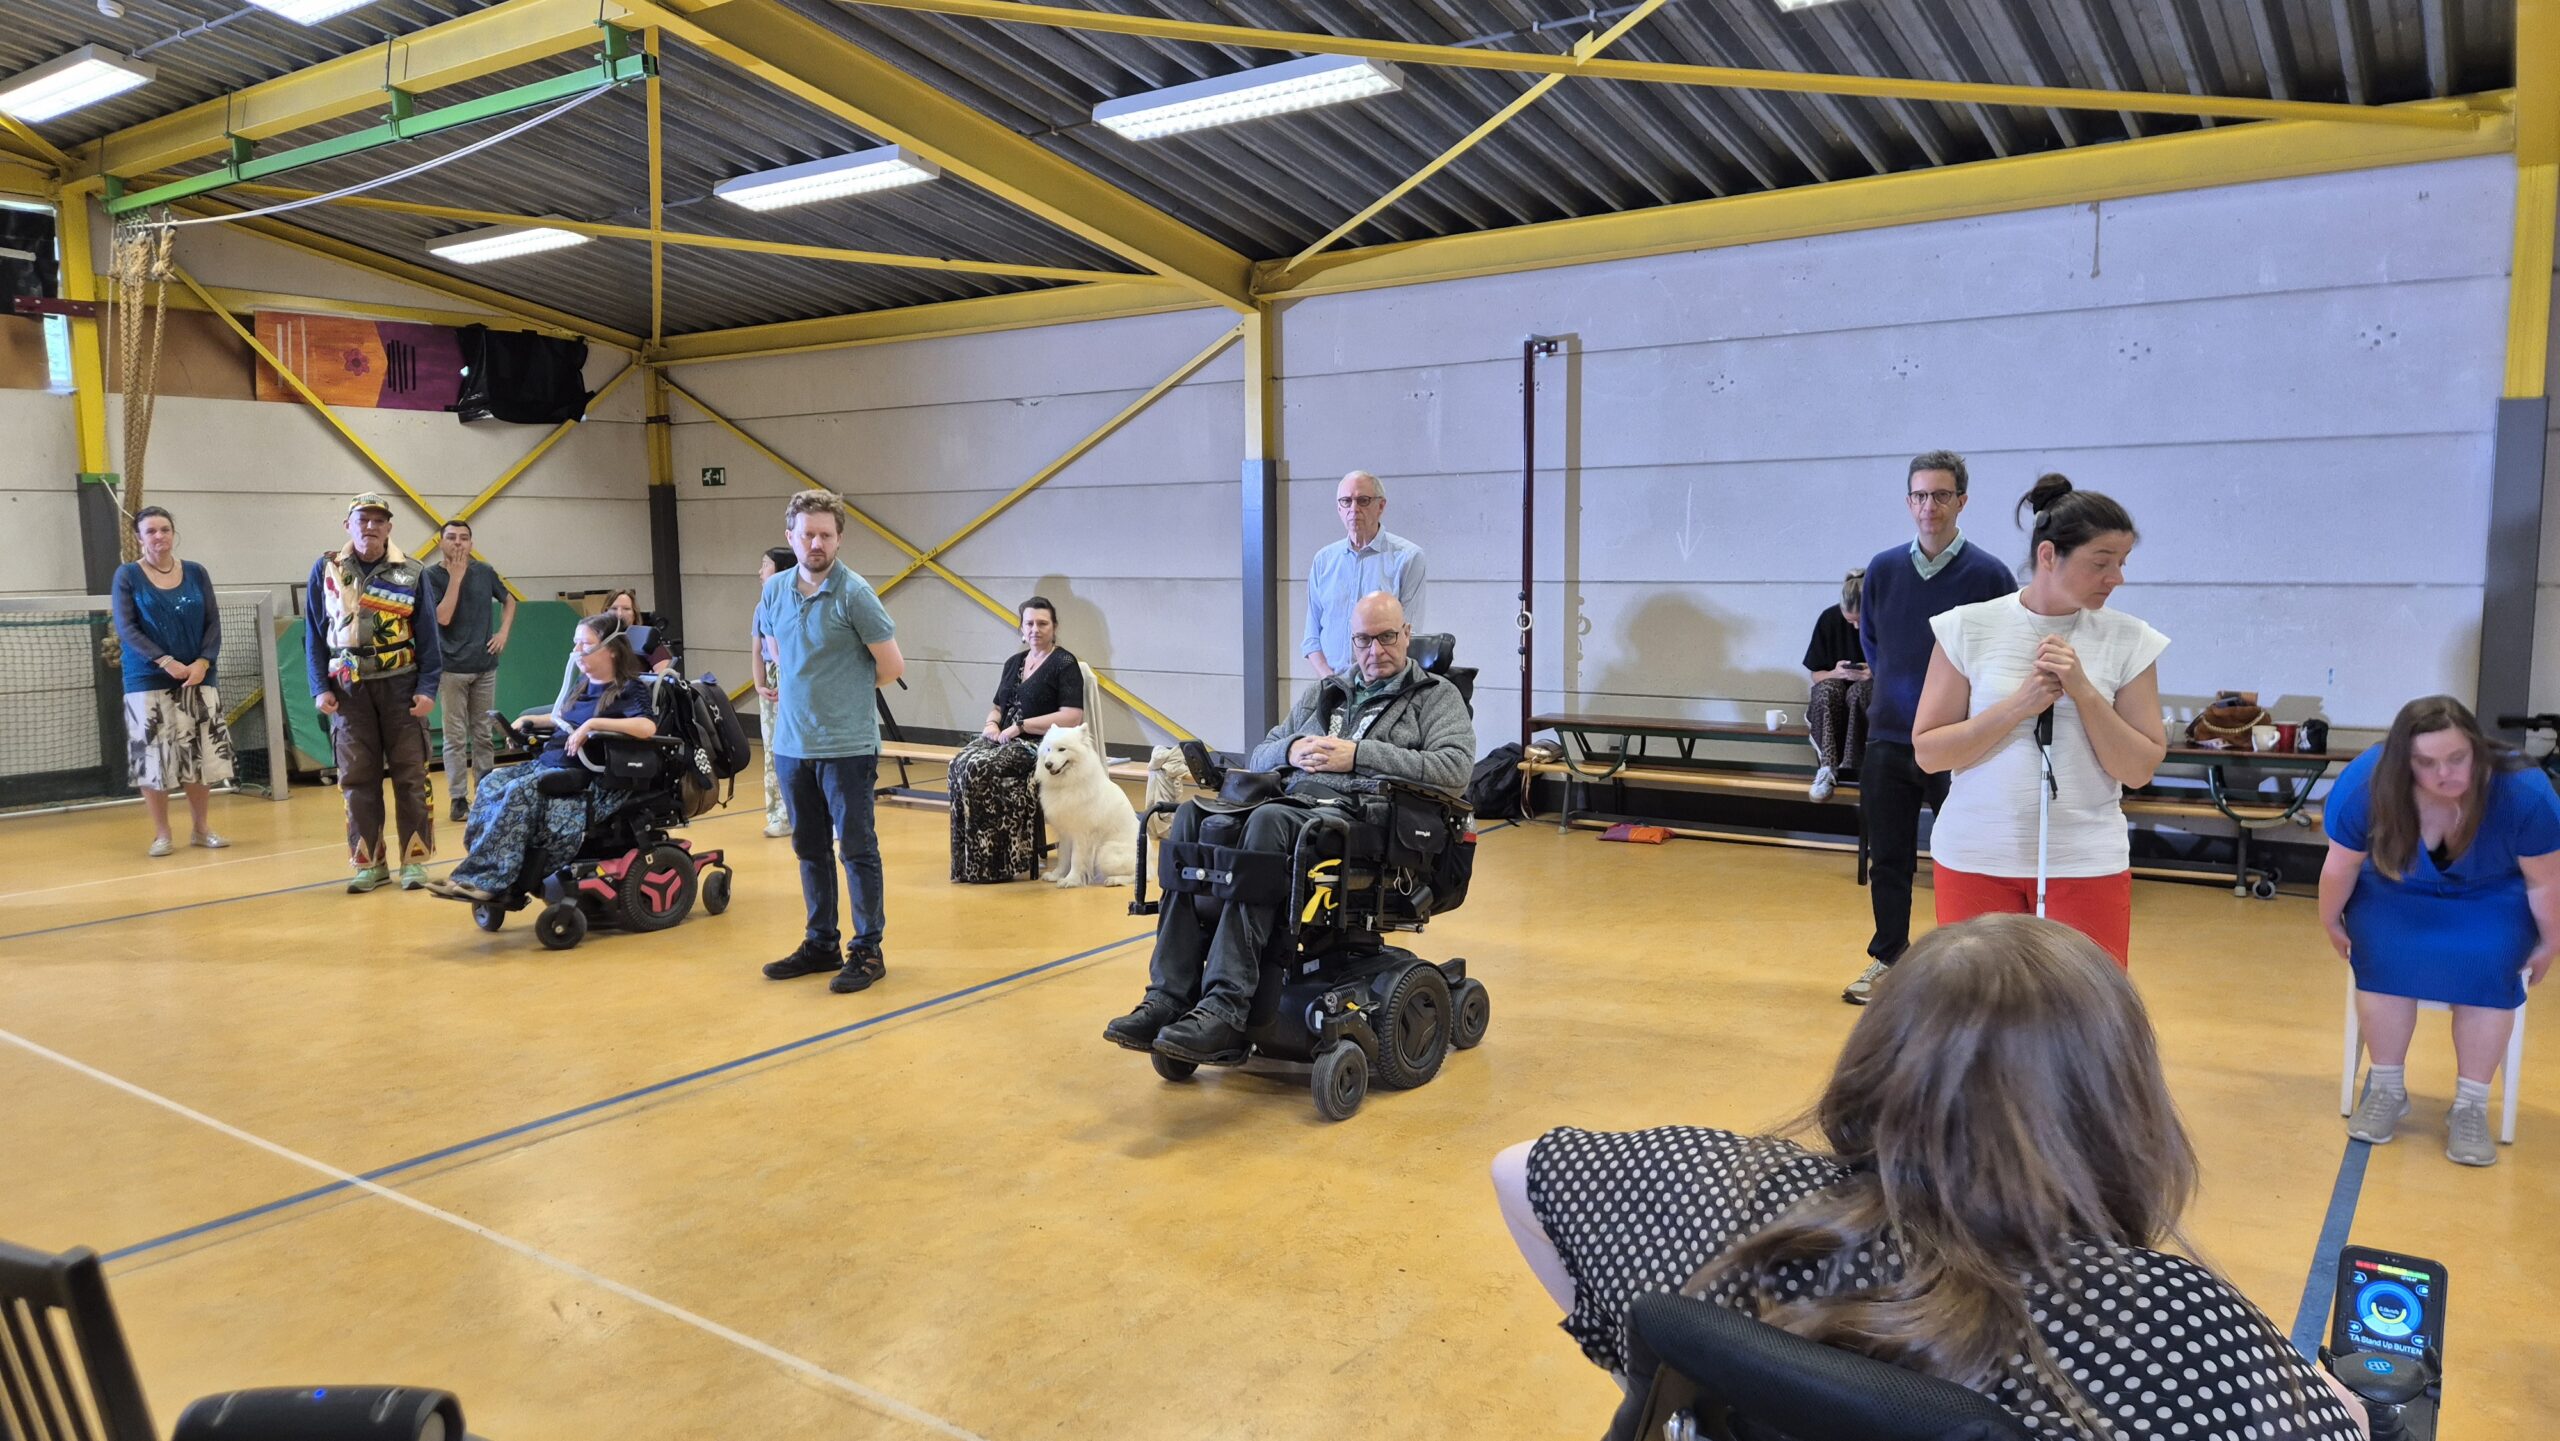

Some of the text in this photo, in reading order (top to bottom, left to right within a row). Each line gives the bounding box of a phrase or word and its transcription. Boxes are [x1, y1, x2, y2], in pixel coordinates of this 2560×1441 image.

[369, 586, 415, 605] PEACE
[2350, 1333, 2423, 1355] TA Stand Up BUITEN
